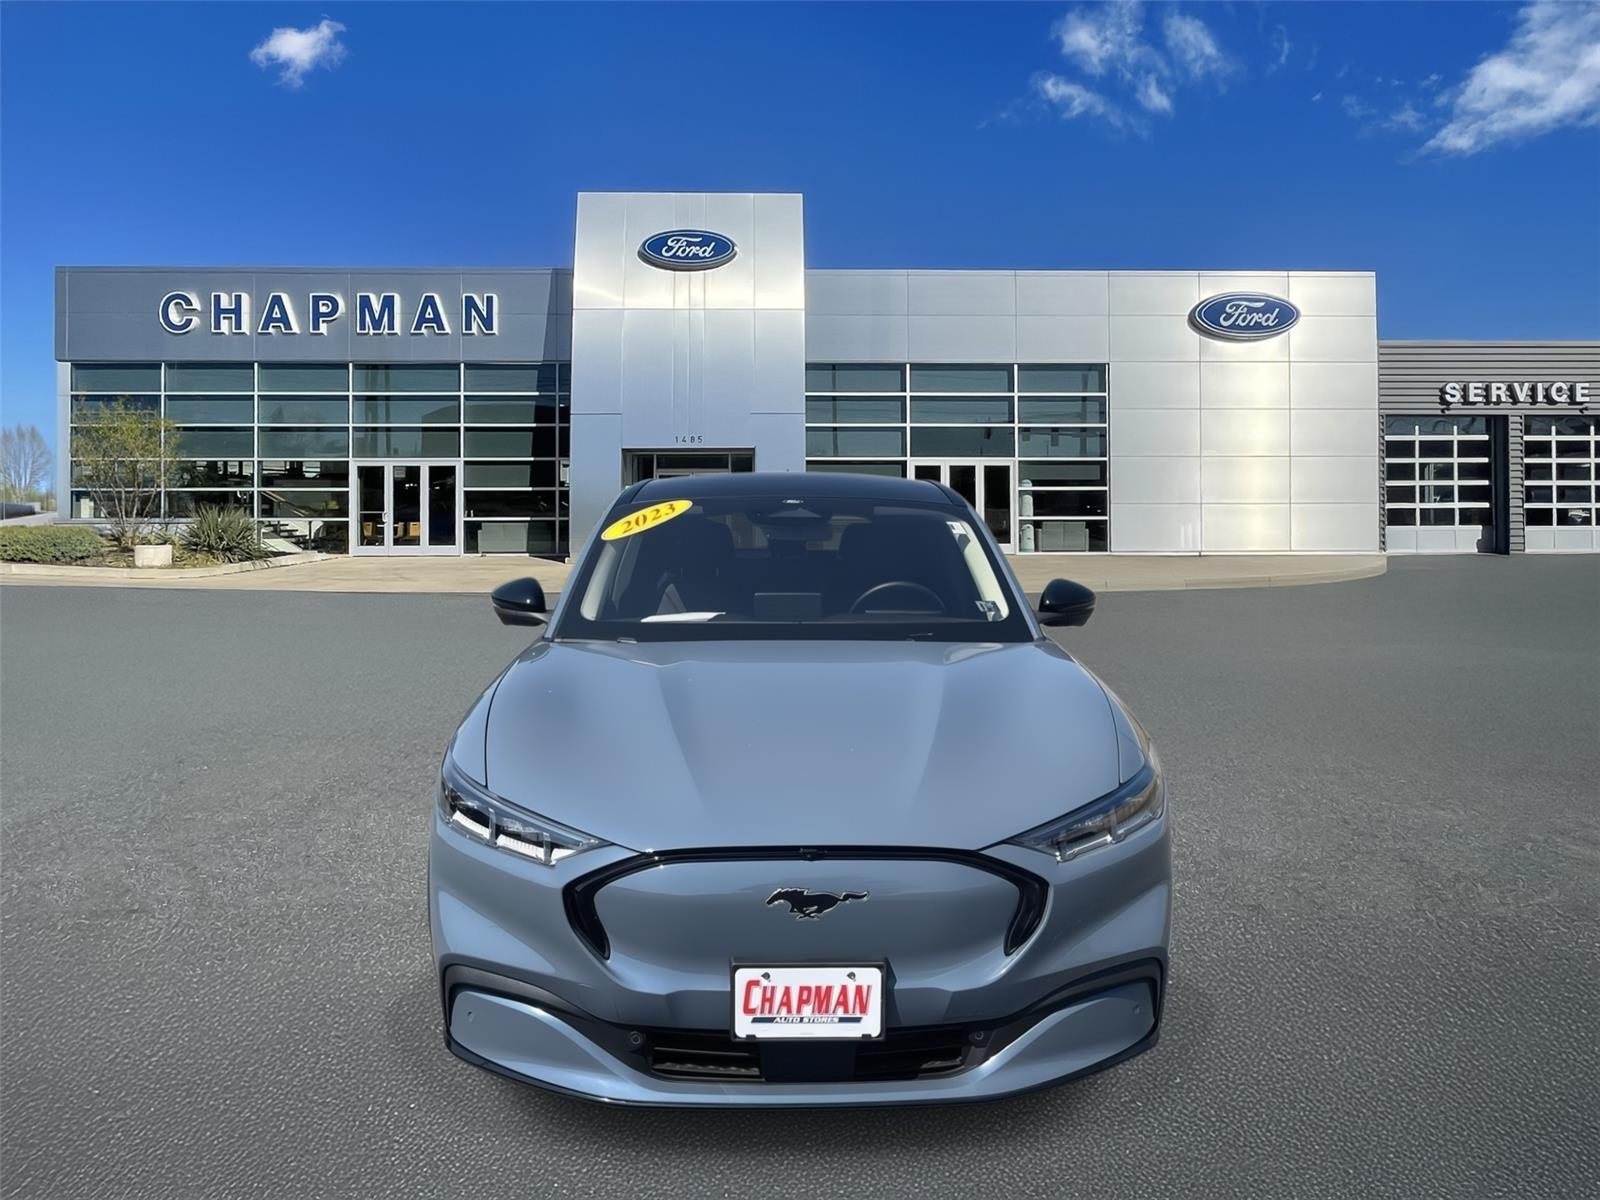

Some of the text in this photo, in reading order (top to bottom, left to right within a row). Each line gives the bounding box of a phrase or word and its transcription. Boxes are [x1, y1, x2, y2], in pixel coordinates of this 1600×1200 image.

[661, 236, 716, 258] Ford
[159, 291, 499, 335] CHAPMAN
[1219, 301, 1280, 327] Ford
[1444, 381, 1591, 403] SERVICE
[675, 435, 703, 443] 1485
[622, 503, 676, 534] 2023
[742, 979, 872, 1016] CHAPMAN
[773, 1016, 840, 1024] AUTO STORES
